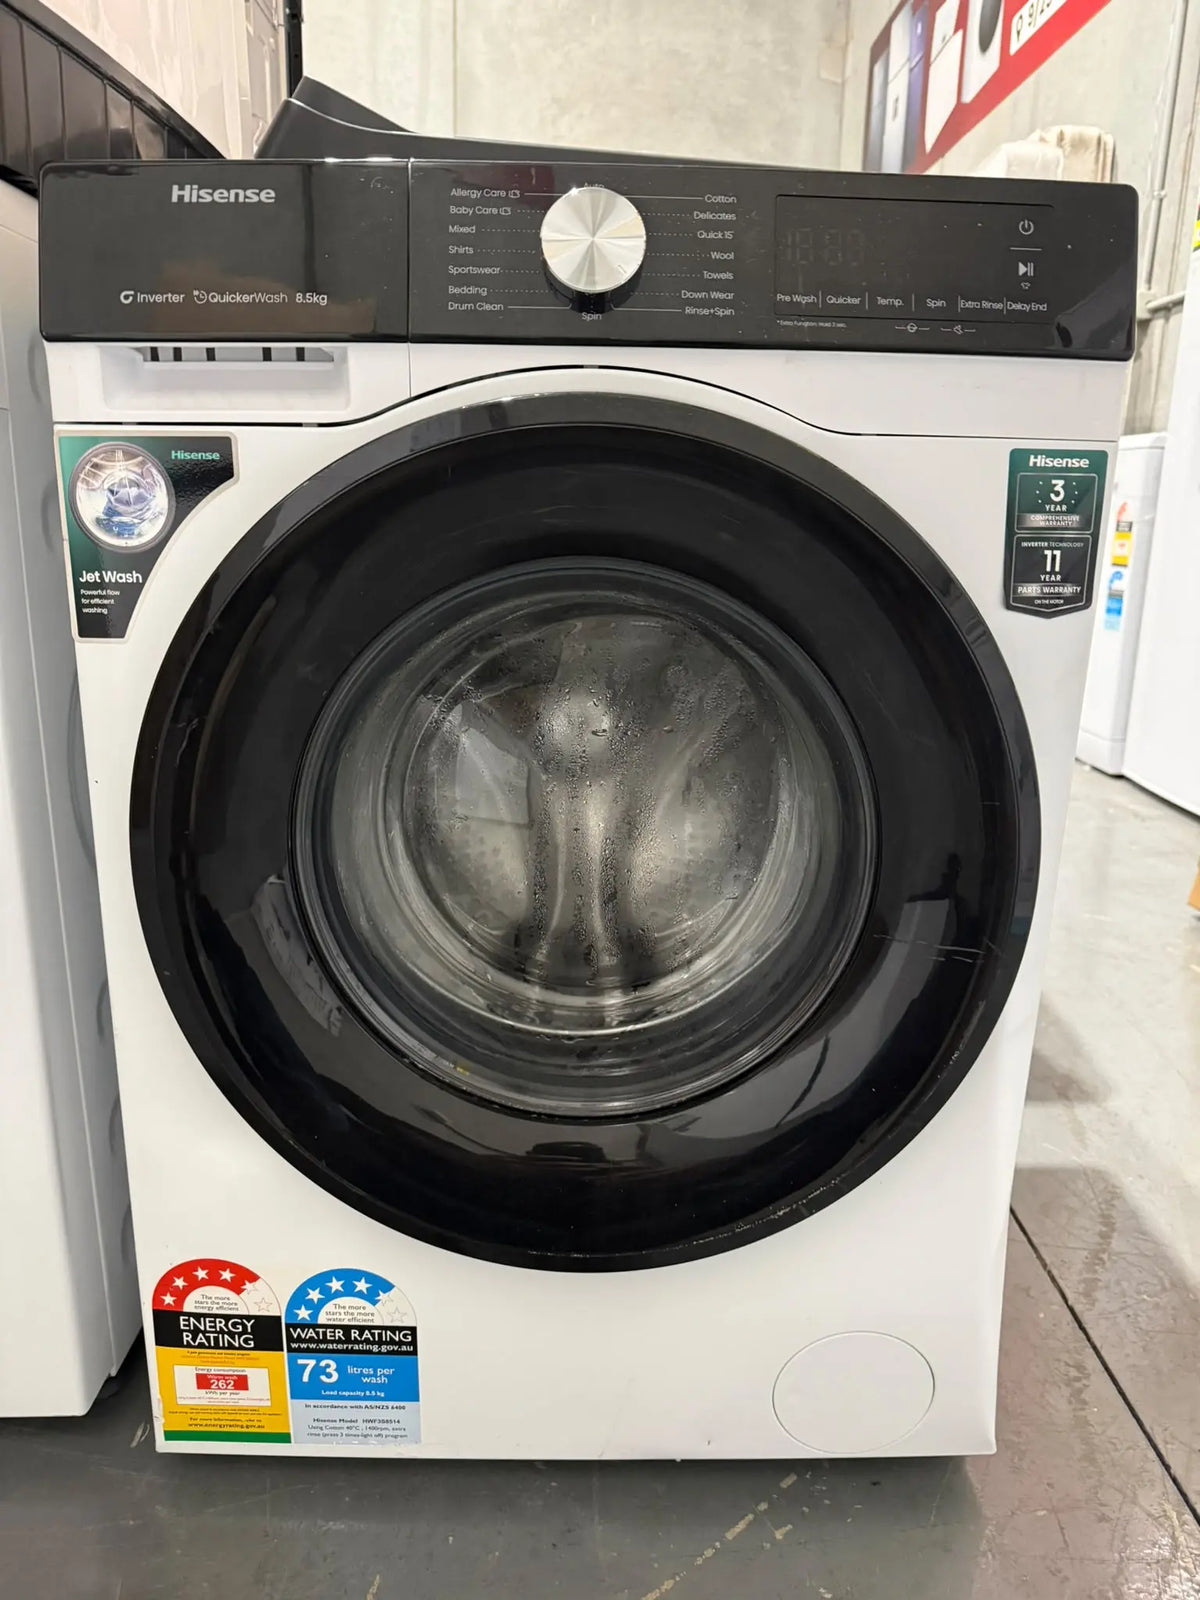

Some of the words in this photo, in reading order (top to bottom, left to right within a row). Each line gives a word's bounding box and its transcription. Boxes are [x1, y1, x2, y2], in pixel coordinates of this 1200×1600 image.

[171, 184, 276, 203] Hisense
[450, 188, 482, 198] Allergy
[484, 188, 506, 197] Care
[704, 194, 736, 204] Cotton
[450, 206, 474, 216] Baby
[475, 206, 498, 214] Care
[694, 211, 736, 220] Delicates
[449, 225, 476, 233] Mixed
[697, 230, 723, 240] Quick
[448, 245, 474, 254] Shirts
[710, 251, 735, 260] Wool
[448, 265, 500, 275] Sportswear
[703, 270, 734, 280] Towels
[448, 286, 487, 296] Bedding
[682, 290, 708, 299] Down
[710, 291, 735, 300] Wear
[137, 292, 185, 303] Inverter
[208, 292, 288, 303] QuickerWash
[296, 293, 328, 305] 8.5kg
[777, 293, 791, 302] Pre
[792, 294, 817, 303] Wash
[826, 295, 861, 304] Quicker
[877, 296, 904, 307] Temp.
[926, 298, 946, 308] Spin
[448, 302, 474, 310] Drum
[476, 302, 504, 310] Clean
[961, 300, 980, 308] Extra
[982, 300, 1003, 310] Rinse
[1007, 302, 1030, 312] Delay
[1032, 303, 1047, 311] End
[685, 306, 735, 316] Rinse+Spin
[582, 312, 602, 322] Spin
[171, 450, 220, 460] Hisense
[1028, 455, 1090, 468] Hisense
[1050, 480, 1065, 502] 3
[1044, 550, 1061, 572] 11
[79, 570, 101, 583] Jet
[102, 570, 142, 583] Wash
[1018, 586, 1041, 594] PARTS
[1043, 586, 1081, 594] WARRANTY
[82, 607, 108, 615] washing
[179, 1316, 255, 1332] ENERGY
[183, 1332, 254, 1348] RATING
[289, 1328, 346, 1340] WATER
[351, 1330, 412, 1342] RATING
[290, 1342, 413, 1352] www.waterrating.gov.au
[297, 1359, 339, 1383] 73
[347, 1365, 374, 1375] litres
[377, 1367, 395, 1376] per
[361, 1375, 388, 1384] wash
[210, 1380, 235, 1390] 262
